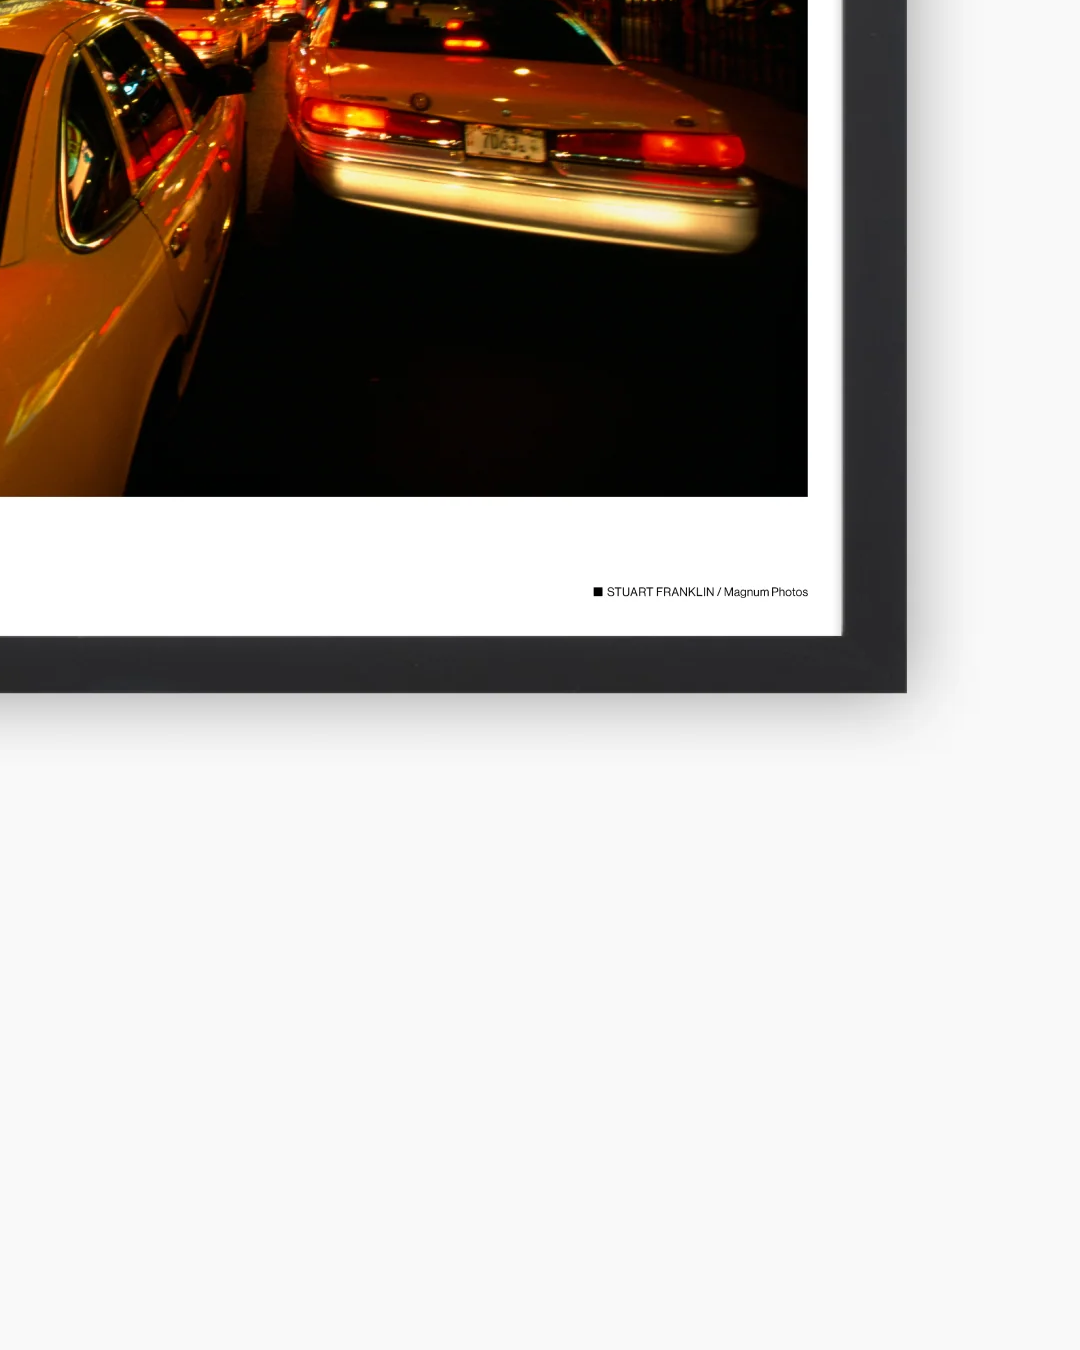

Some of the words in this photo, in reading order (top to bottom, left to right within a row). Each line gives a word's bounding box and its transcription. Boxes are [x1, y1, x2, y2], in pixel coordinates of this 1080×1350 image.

[607, 587, 653, 597] STUART
[656, 587, 714, 597] FRANKLIN
[723, 587, 770, 599] Magnum
[771, 587, 809, 597] Photos
